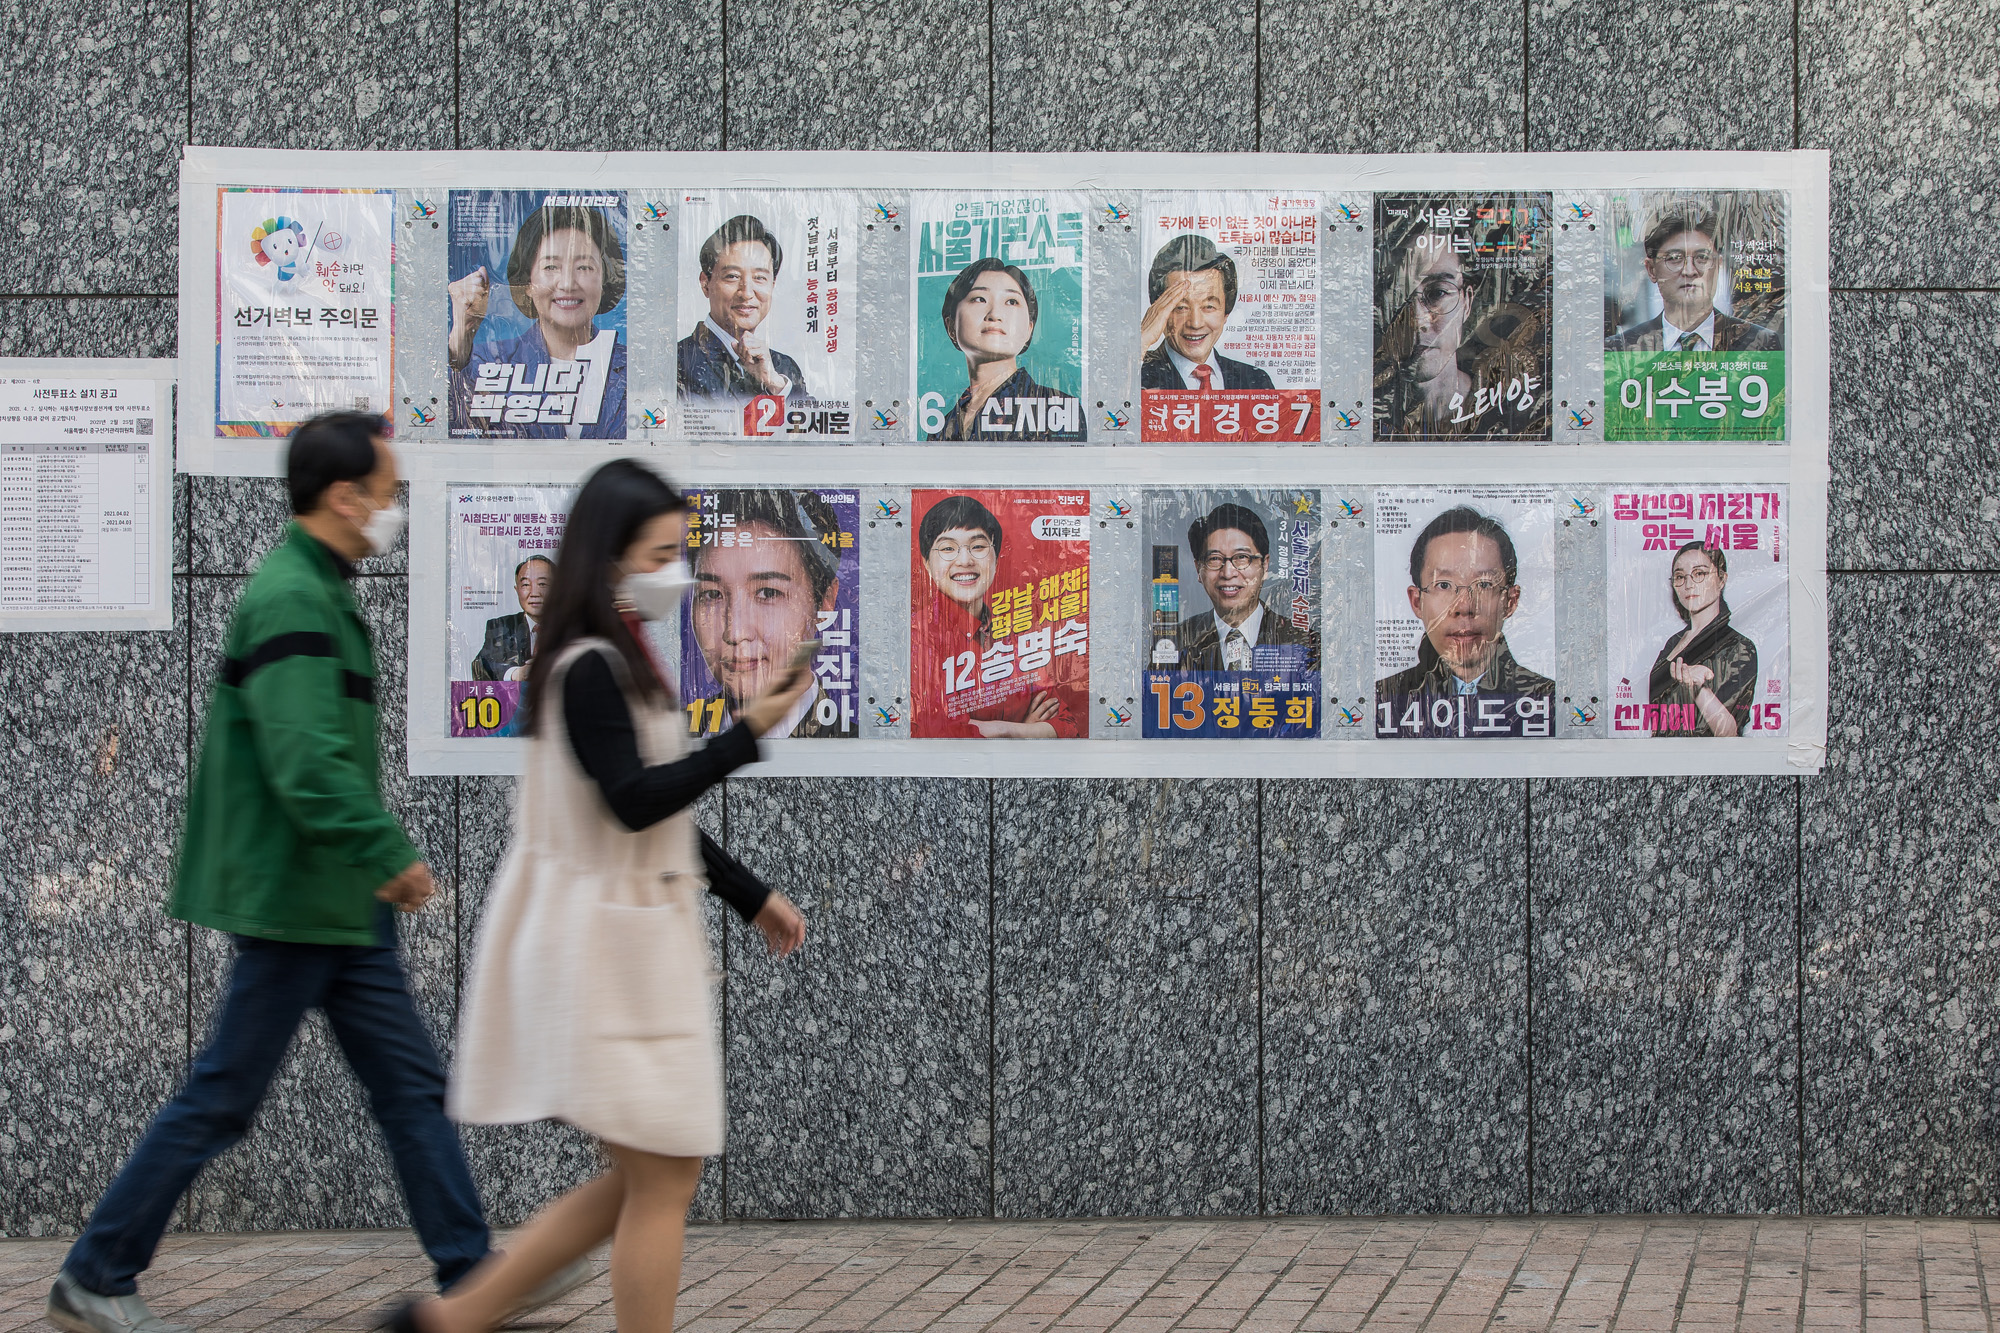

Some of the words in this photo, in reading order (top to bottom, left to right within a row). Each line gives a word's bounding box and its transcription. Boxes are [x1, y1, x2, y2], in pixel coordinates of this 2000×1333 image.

[543, 196, 580, 207] 서울시
[1158, 216, 1194, 230] 국가에
[1198, 216, 1222, 230] 돈이
[1226, 216, 1249, 230] 없는
[1254, 216, 1277, 230] 것이
[1281, 216, 1317, 230] 아니라
[1416, 208, 1472, 228] 서울은
[807, 216, 819, 272] 첫날부터
[1218, 231, 1265, 245] 도둑놈이
[1269, 231, 1317, 245] 많습니다
[1416, 234, 1472, 254] 이기는
[826, 228, 838, 283] 서울부터
[1234, 247, 1251, 256] 국가
[1254, 247, 1279, 256] 미래를
[1282, 247, 1316, 256] 내다보는
[1252, 258, 1286, 268] 허경영이
[316, 261, 364, 277] 훼손하면
[1257, 269, 1266, 278] 그
[1268, 269, 1294, 278] 나물에
[1296, 269, 1305, 278] 그
[1308, 269, 1316, 278] 밥
[1734, 268, 1752, 279] 서민
[1754, 268, 1772, 279] 행복
[322, 279, 336, 293] 안
[339, 282, 365, 293] 돼요!
[1260, 280, 1277, 290] 이제
[1734, 282, 1752, 293] 서울
[1754, 282, 1772, 293] 혁명
[807, 278, 819, 334] 능숙하게
[1238, 294, 1261, 303] 서울시
[1264, 294, 1280, 303] 예산
[1282, 294, 1297, 303] 70%
[234, 306, 312, 328] 선거벽보
[320, 308, 378, 329] 주의문
[475, 362, 585, 393] 합니다
[575, 329, 617, 426] 1
[1652, 362, 1682, 371] 기본소득
[1684, 362, 1692, 371] 첫
[1694, 362, 1719, 371] 주창자,
[1753, 362, 1768, 371] 대표
[33, 389, 77, 399] 사전투표소
[80, 389, 97, 399] 설치
[100, 389, 118, 399] 공고
[789, 400, 850, 409] 서울특별시장후보
[1449, 372, 1540, 424] 오태양
[1620, 376, 1732, 419] 이수봉
[1739, 375, 1769, 419] 9
[470, 394, 576, 424] 박영선
[757, 398, 779, 433] 2
[920, 392, 945, 434] 6
[981, 396, 1079, 432] 신지혜
[1172, 402, 1279, 434] 허경영
[1290, 402, 1314, 436] 7
[786, 410, 850, 434] 오세훈
[686, 494, 720, 510] 여자
[820, 494, 855, 504] 여성의당
[1058, 496, 1084, 505] 진보당
[1614, 493, 1694, 521] 당신의
[1699, 493, 1780, 521] 자리가
[460, 513, 511, 523] "AI첨단도시"
[514, 514, 547, 523] 에덴동산
[550, 514, 566, 523] 공원
[686, 513, 736, 528] 혼자도
[480, 526, 521, 536] 메디컬시티
[524, 526, 544, 536] 조성,
[686, 532, 753, 548] 살기좋은
[820, 532, 854, 548] 서울
[1042, 528, 1080, 537] 지지후보
[1278, 521, 1288, 542] 3시
[1292, 520, 1310, 556] 서울
[1642, 524, 1694, 551] 있는
[1704, 524, 1759, 551] 서울
[518, 539, 560, 549] 예산효율화
[1278, 546, 1288, 580] 정동희
[1292, 559, 1310, 595] 경제
[991, 583, 1034, 616] 강남
[1039, 566, 1088, 605] 해체!
[991, 609, 1034, 640] 평등
[1038, 590, 1088, 626] 서울!
[942, 651, 976, 695] 12
[981, 619, 1088, 686] 송명숙
[816, 608, 854, 732] 김진아
[470, 686, 494, 695] 기호
[461, 696, 502, 730] 10
[687, 699, 725, 733] 11
[1151, 682, 1205, 730] 13
[1212, 696, 1312, 729] 정동희
[1378, 701, 1423, 734] 14
[1432, 696, 1550, 737] 이도엽
[1614, 704, 1695, 731] 신지예
[1752, 704, 1781, 730] 15
